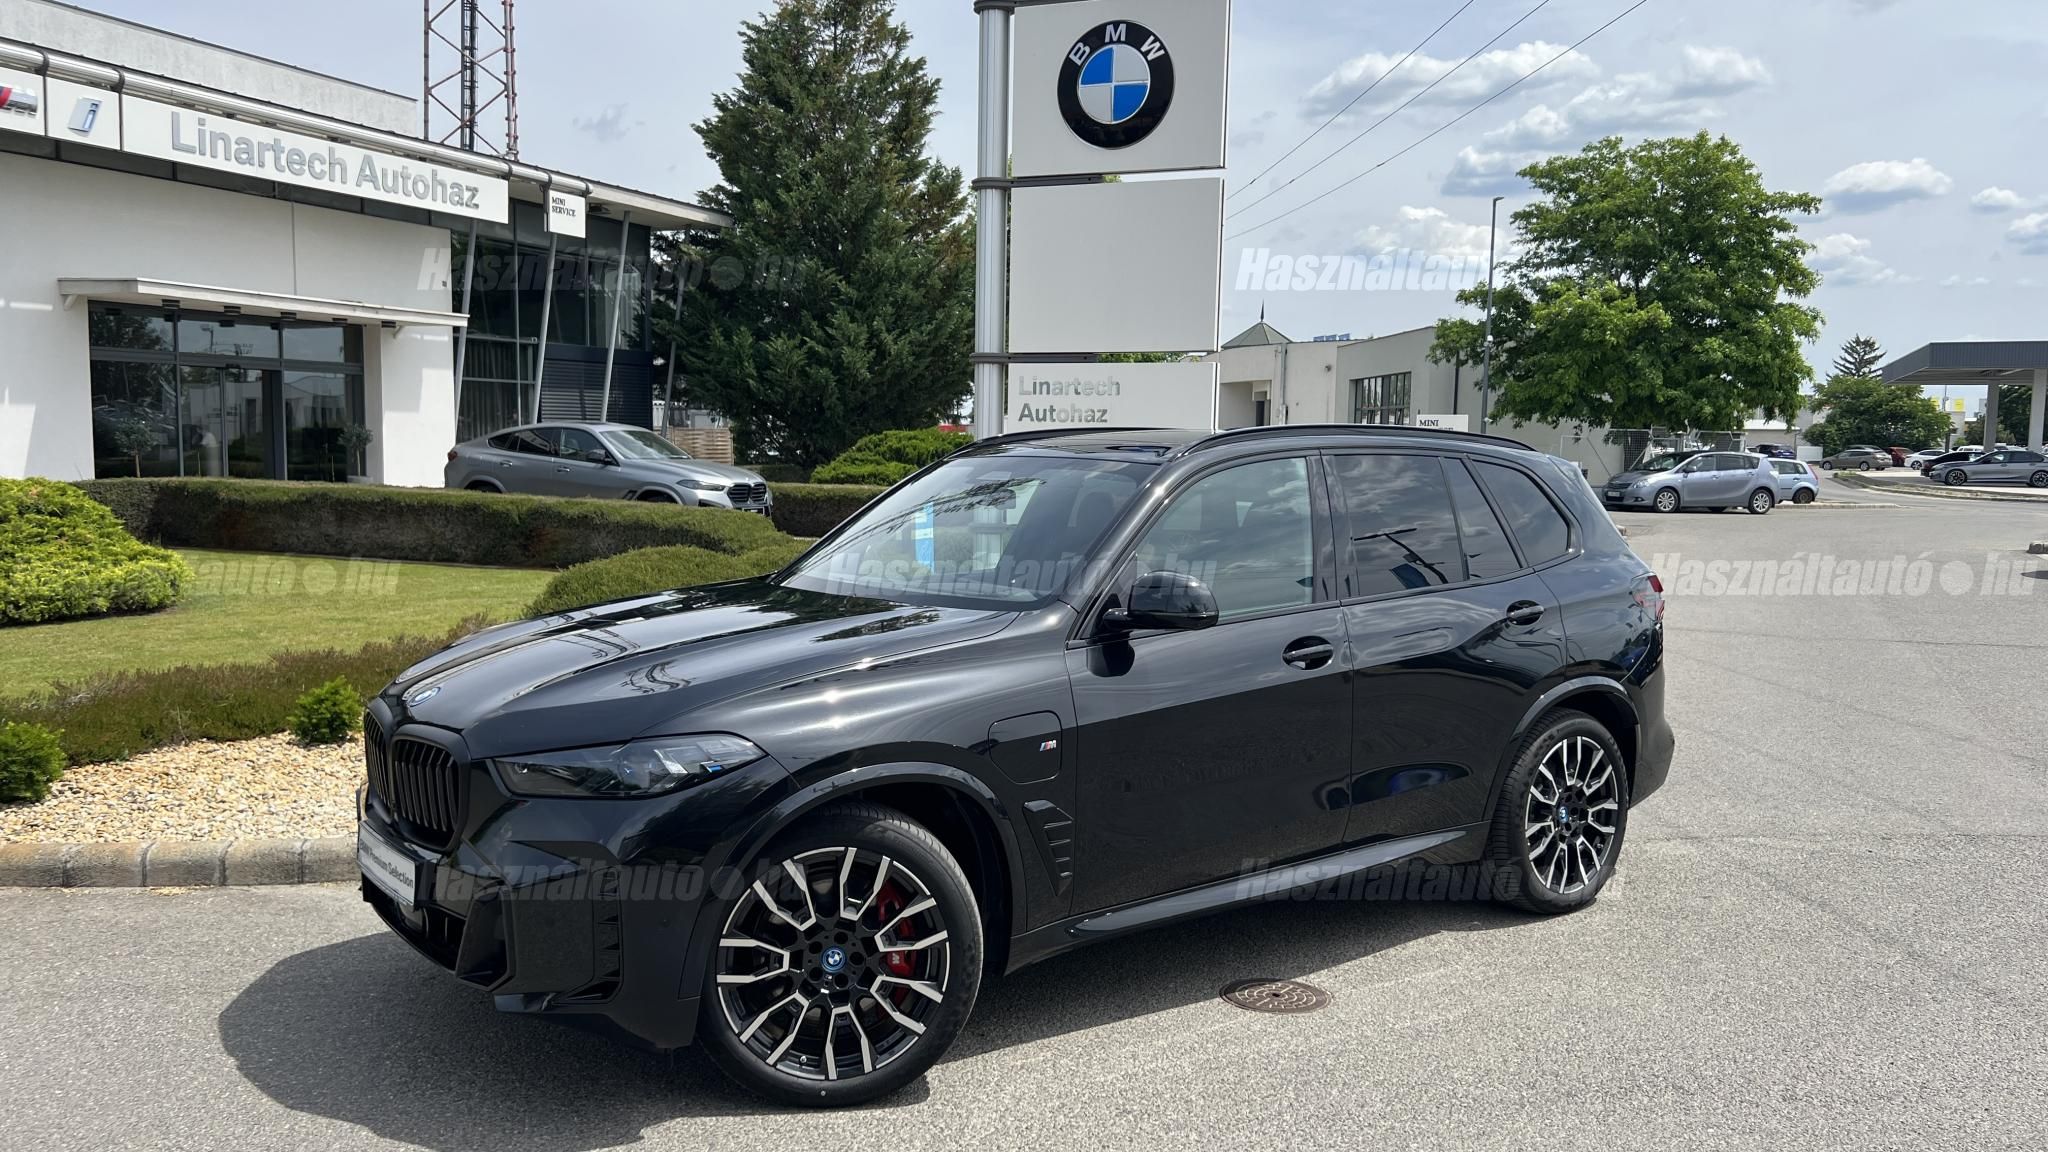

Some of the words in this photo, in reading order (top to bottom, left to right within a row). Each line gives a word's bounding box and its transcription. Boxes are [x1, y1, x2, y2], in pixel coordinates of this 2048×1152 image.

[1068, 23, 1165, 66] BMW
[171, 111, 348, 185] Linartech
[355, 153, 480, 209] Autohaz
[551, 196, 566, 207] MINI
[551, 205, 577, 217] SERVICE
[1019, 376, 1121, 396] Linartech
[1018, 402, 1108, 423] Autohaz
[1419, 419, 1440, 428] MINI
[388, 862, 414, 889] Selection
